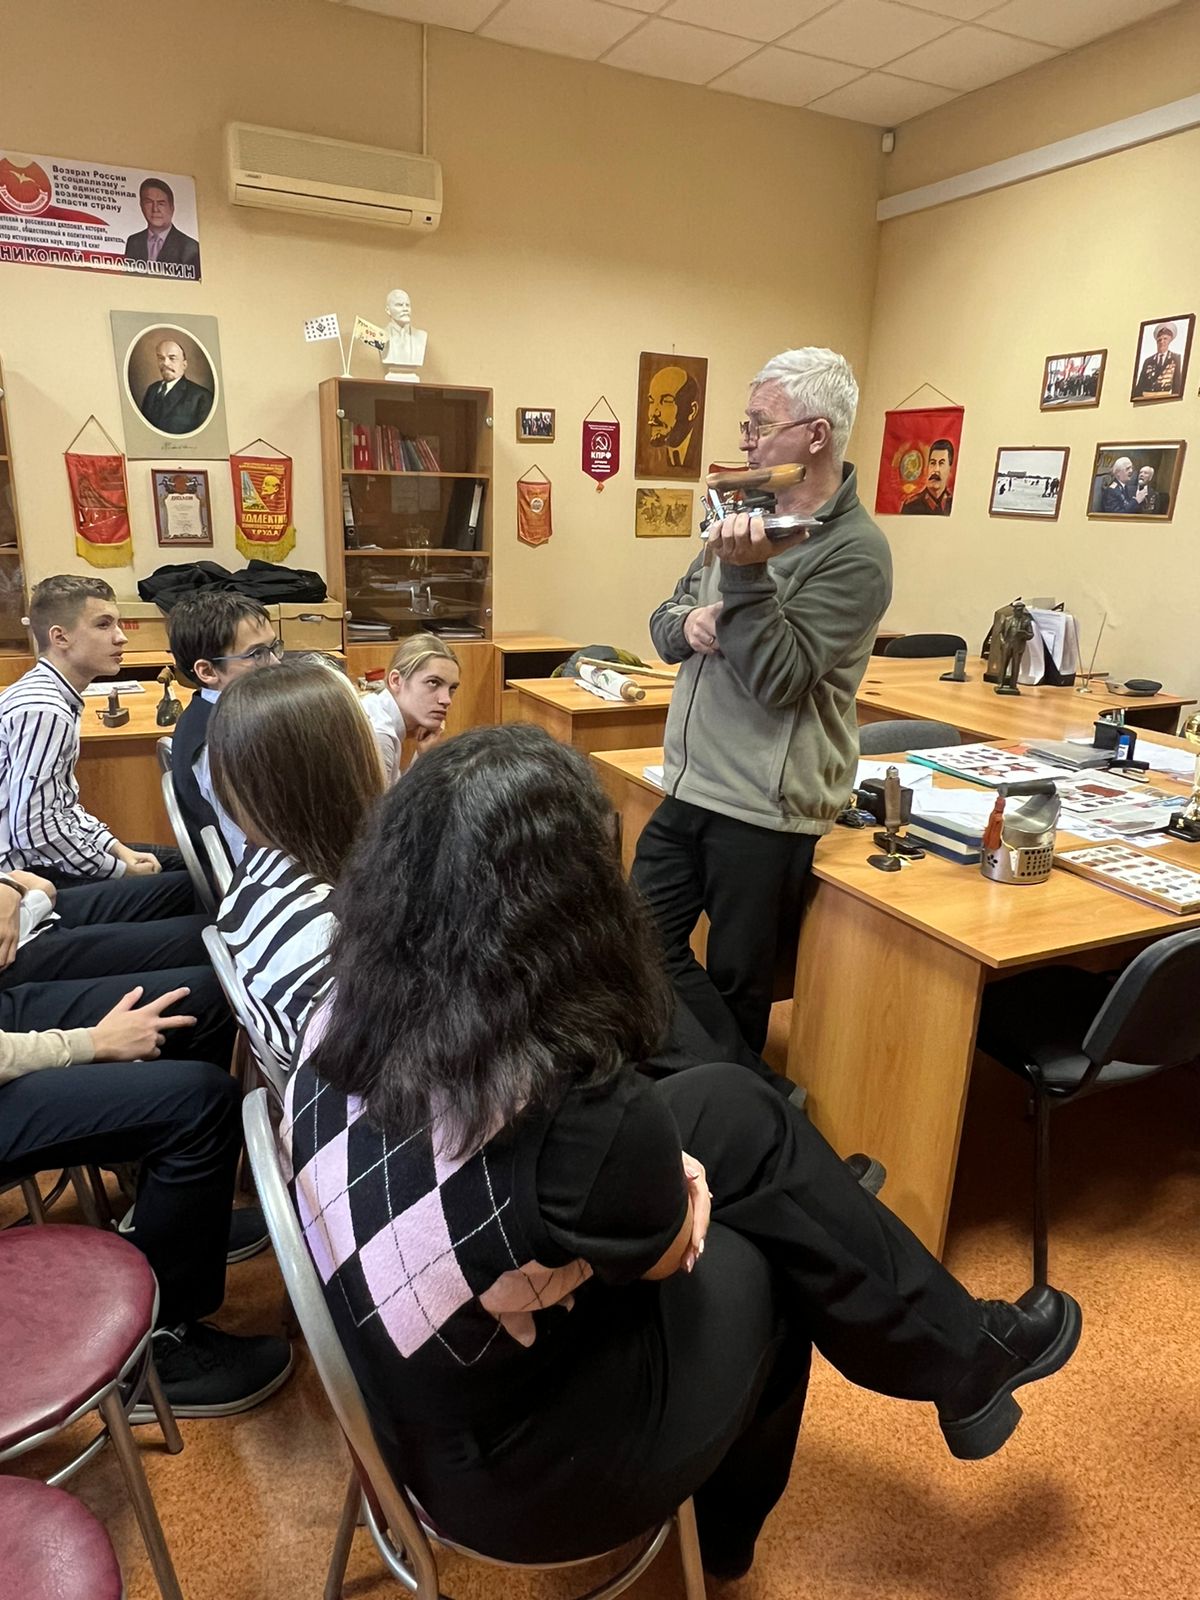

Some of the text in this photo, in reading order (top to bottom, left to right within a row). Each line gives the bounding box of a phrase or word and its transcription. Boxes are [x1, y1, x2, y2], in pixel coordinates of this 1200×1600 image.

[52, 165, 127, 182] Возврат России
[54, 182, 137, 198] это единственная
[61, 175, 119, 190] социализму
[55, 190, 117, 204] возможность
[56, 198, 122, 213] спасти страну
[0, 245, 196, 280] НИКОЛАЙ ПЛАТОШКИН
[591, 451, 611, 459] КПРФ
